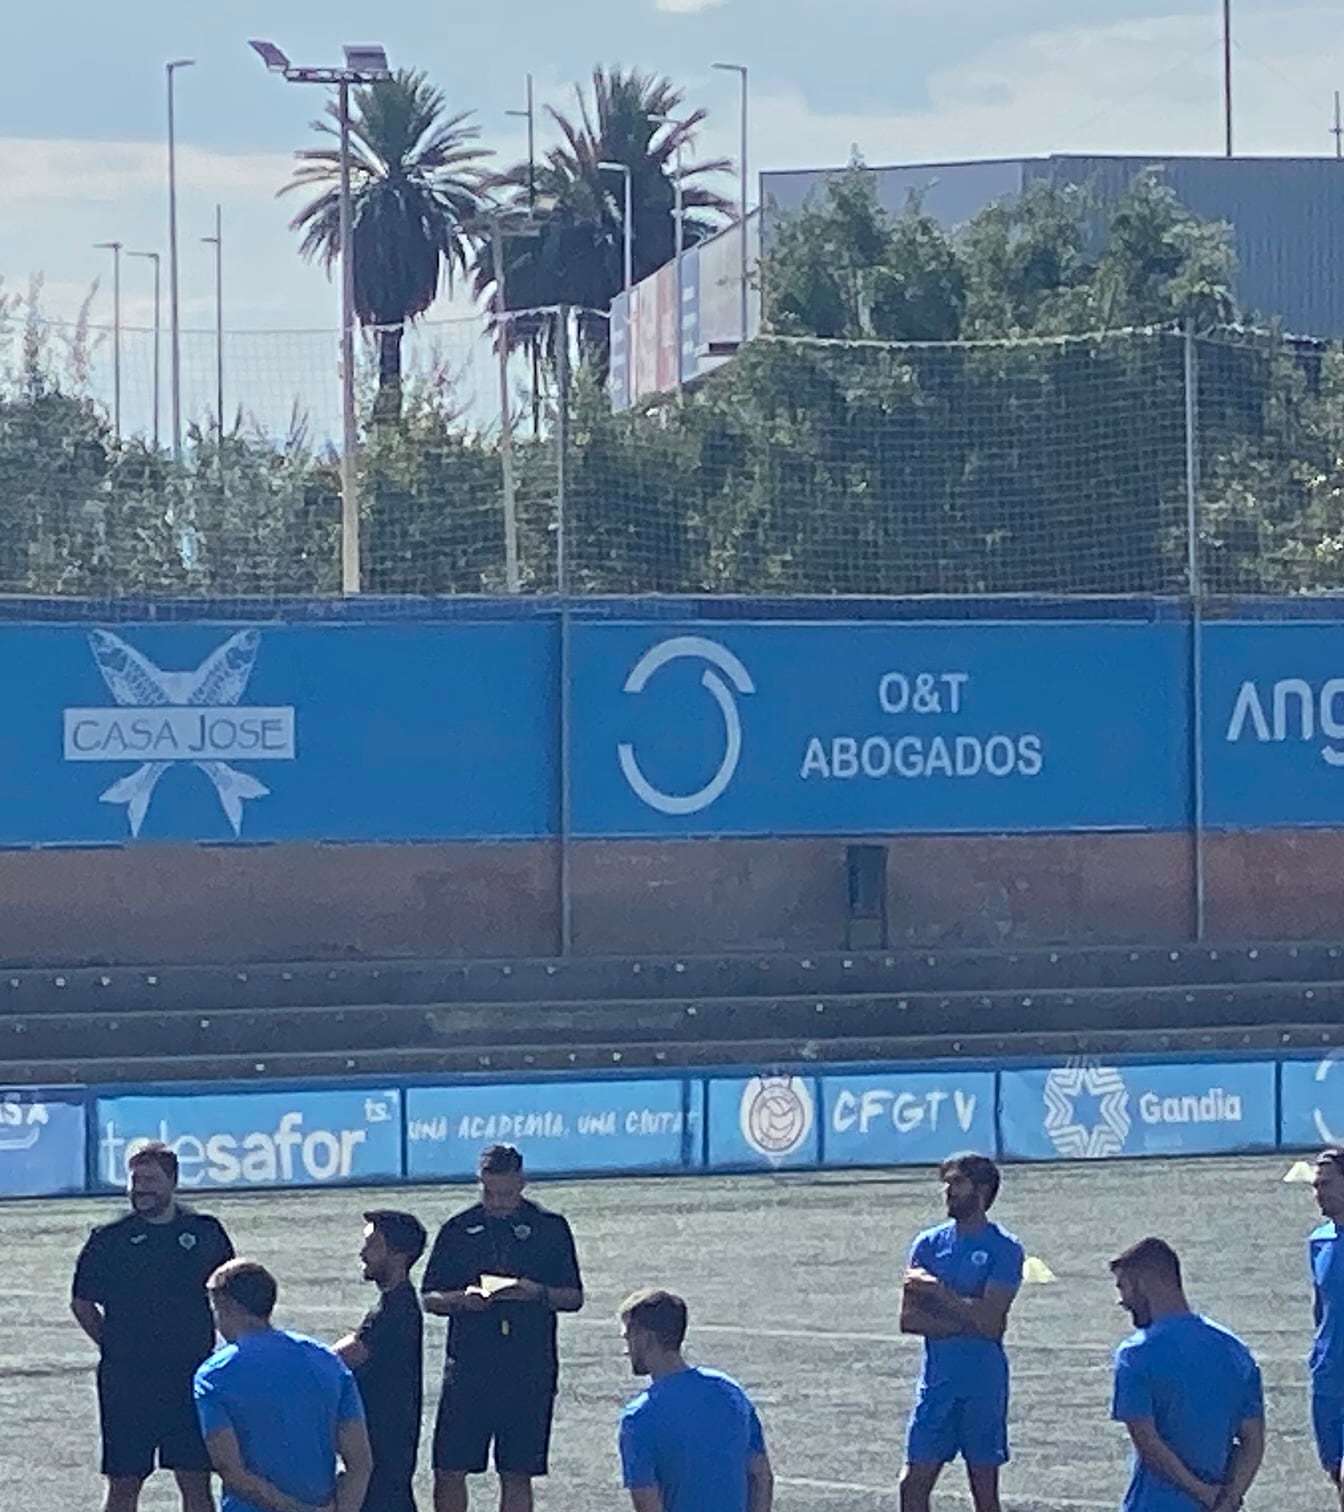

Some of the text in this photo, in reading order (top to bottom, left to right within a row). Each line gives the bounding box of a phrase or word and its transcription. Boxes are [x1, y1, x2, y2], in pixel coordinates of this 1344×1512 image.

[878, 672, 969, 714] O&T
[72, 714, 287, 751] CASA JOSE
[800, 735, 1042, 779] ABOGADOS
[1139, 1087, 1242, 1124] Gandia
[408, 1115, 448, 1141] UNA
[577, 1111, 616, 1138] UNA
